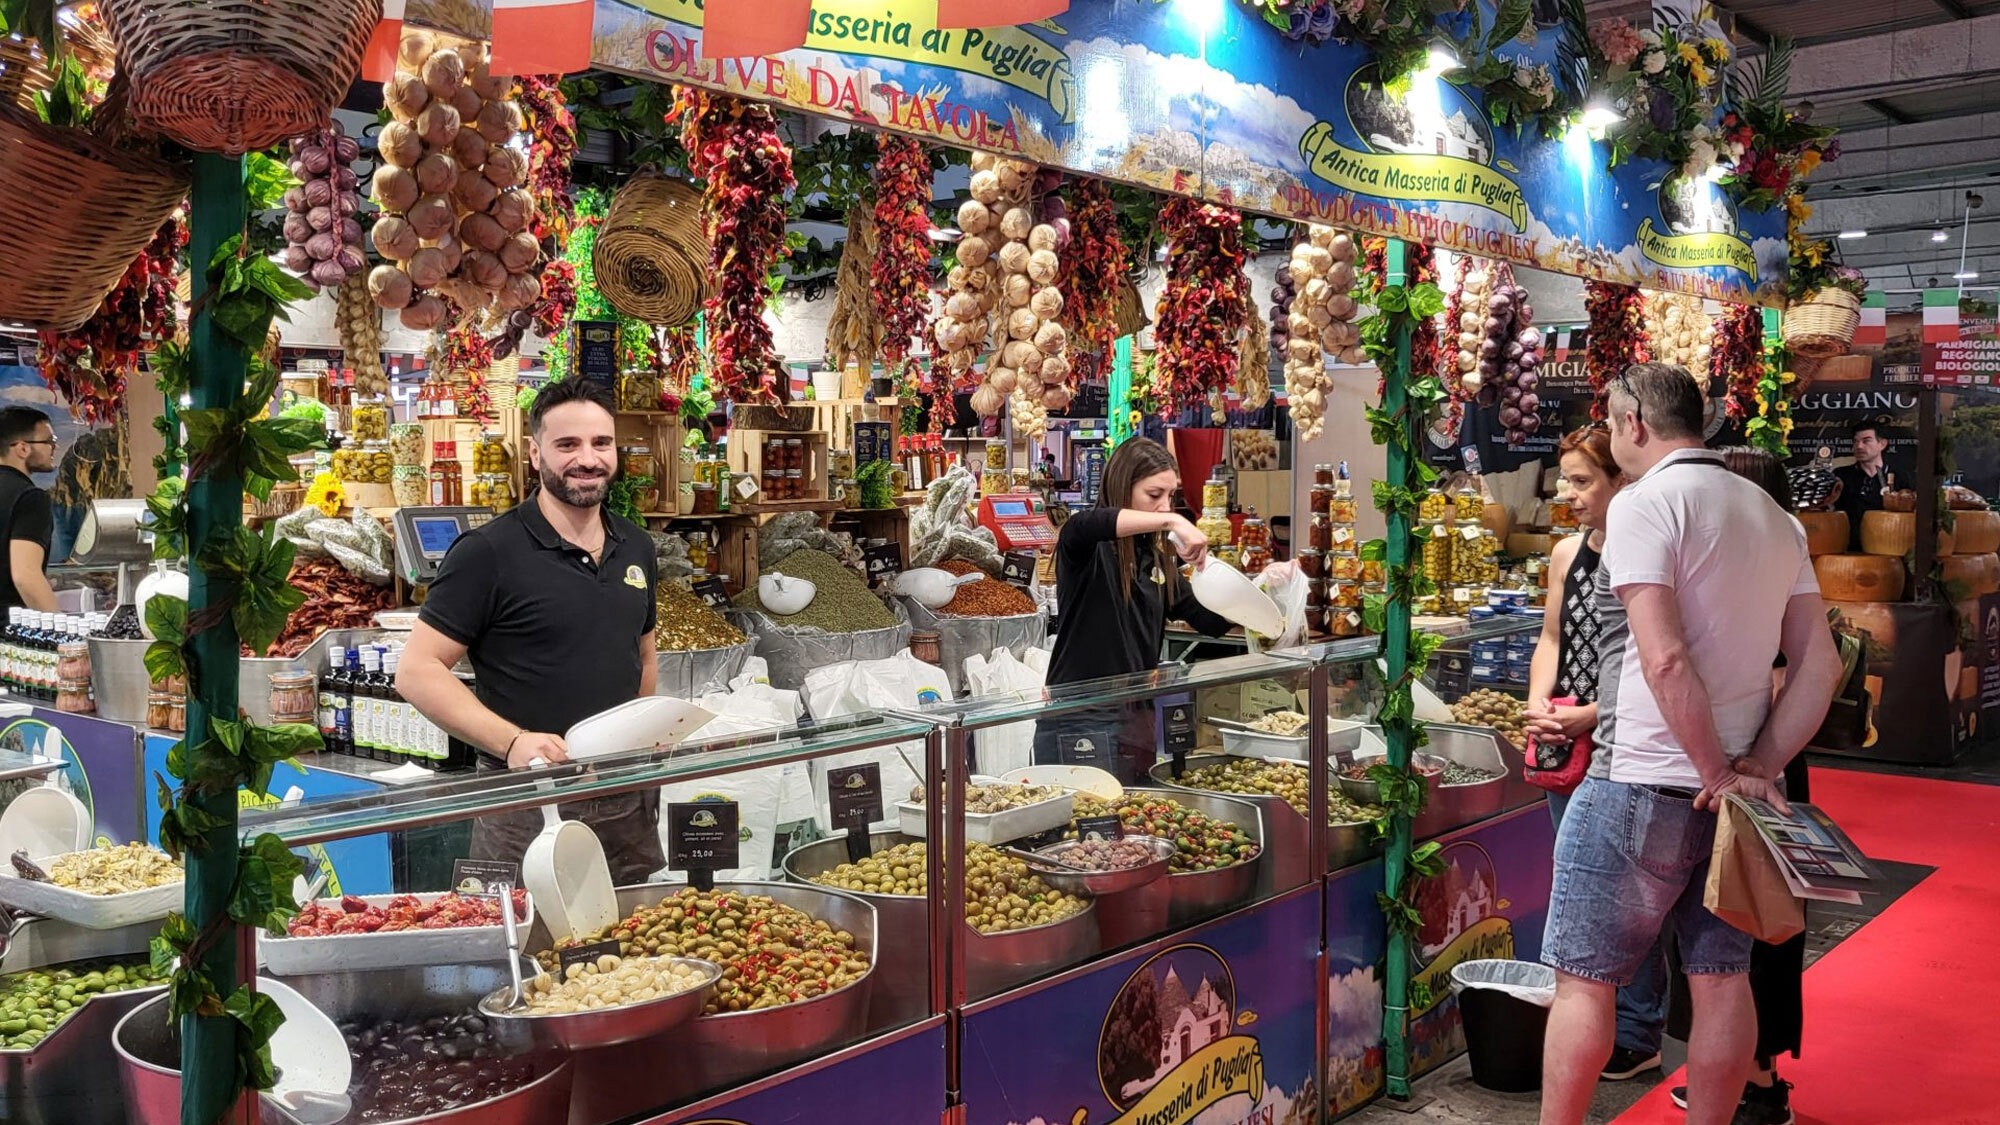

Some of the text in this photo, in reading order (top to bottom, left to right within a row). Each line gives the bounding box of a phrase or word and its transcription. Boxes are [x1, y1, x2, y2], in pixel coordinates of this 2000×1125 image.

[808, 8, 912, 47] sseria
[961, 29, 1051, 80] Puglia
[645, 29, 1022, 153] OLIVE DA TAVOLA
[1321, 149, 1513, 205] Antica Masseria di Puglia
[1286, 184, 1537, 261] PRODOTTI TIPICI PUGLIESI
[1647, 236, 1749, 266] Antica Masseria di Puglia
[1196, 1064, 1209, 1100] di
[1212, 1045, 1250, 1092] Puglia
